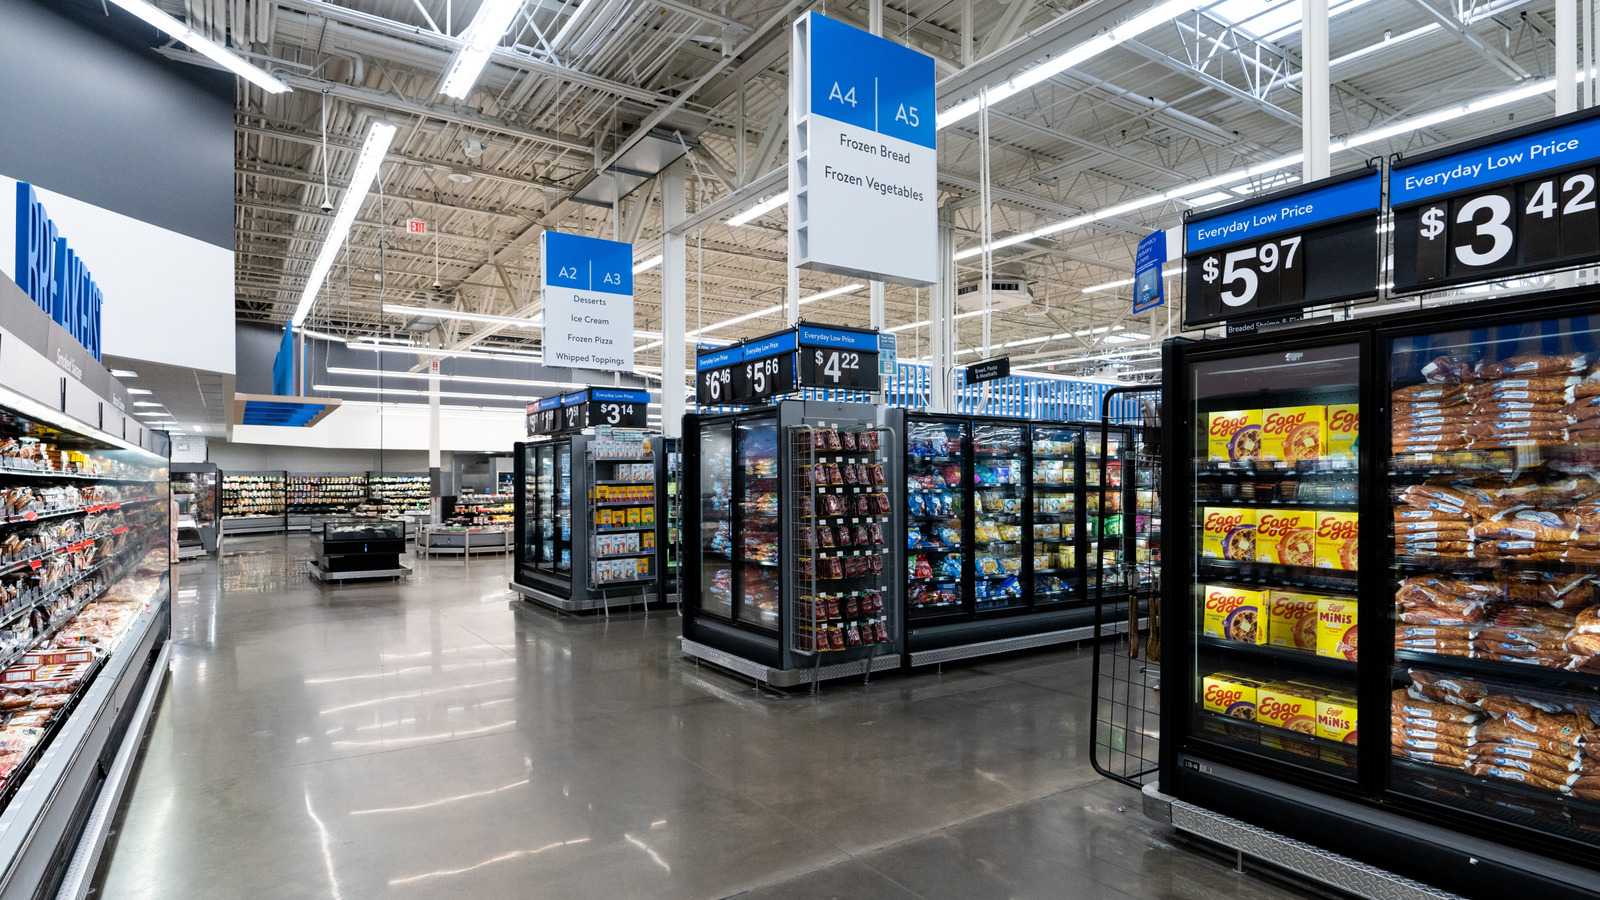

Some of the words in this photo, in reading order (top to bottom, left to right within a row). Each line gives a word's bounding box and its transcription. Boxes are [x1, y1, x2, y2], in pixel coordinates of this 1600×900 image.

[828, 80, 858, 108] A4
[895, 103, 920, 128] A5
[840, 134, 877, 155] Frozen
[880, 144, 910, 164] Bread
[1405, 162, 1482, 190] Everyday
[1488, 152, 1524, 170] Low
[1530, 139, 1579, 160] Price
[825, 166, 863, 188] Frozen
[866, 176, 924, 202] Vegetables
[410, 221, 426, 233] EXIT
[1198, 220, 1250, 241] Everyday
[1253, 214, 1276, 228] Low
[1281, 204, 1314, 220] Price
[558, 266, 577, 279] A2
[603, 272, 620, 285] A3
[573, 295, 606, 306] Desserts
[585, 316, 609, 325] Cream
[1228, 324, 1255, 333] Breaded
[568, 334, 592, 343] Frozen
[595, 336, 613, 345] Pizza
[804, 331, 829, 343] Everyday
[842, 336, 855, 344] Price
[556, 352, 589, 362] Whipped
[592, 355, 624, 366] Toppings
[746, 347, 762, 355] Everyday
[1210, 416, 1248, 437] Eggo
[1264, 412, 1306, 435] Eggo
[1205, 512, 1244, 533] Eggo
[1258, 515, 1300, 536] Eggo
[1206, 592, 1246, 613] Eggo
[1272, 597, 1316, 619] Eggo
[1328, 604, 1345, 612] Eggo
[1205, 684, 1243, 707] Eggo
[1259, 697, 1302, 721] Eggo
[1326, 707, 1343, 716] Eggo
